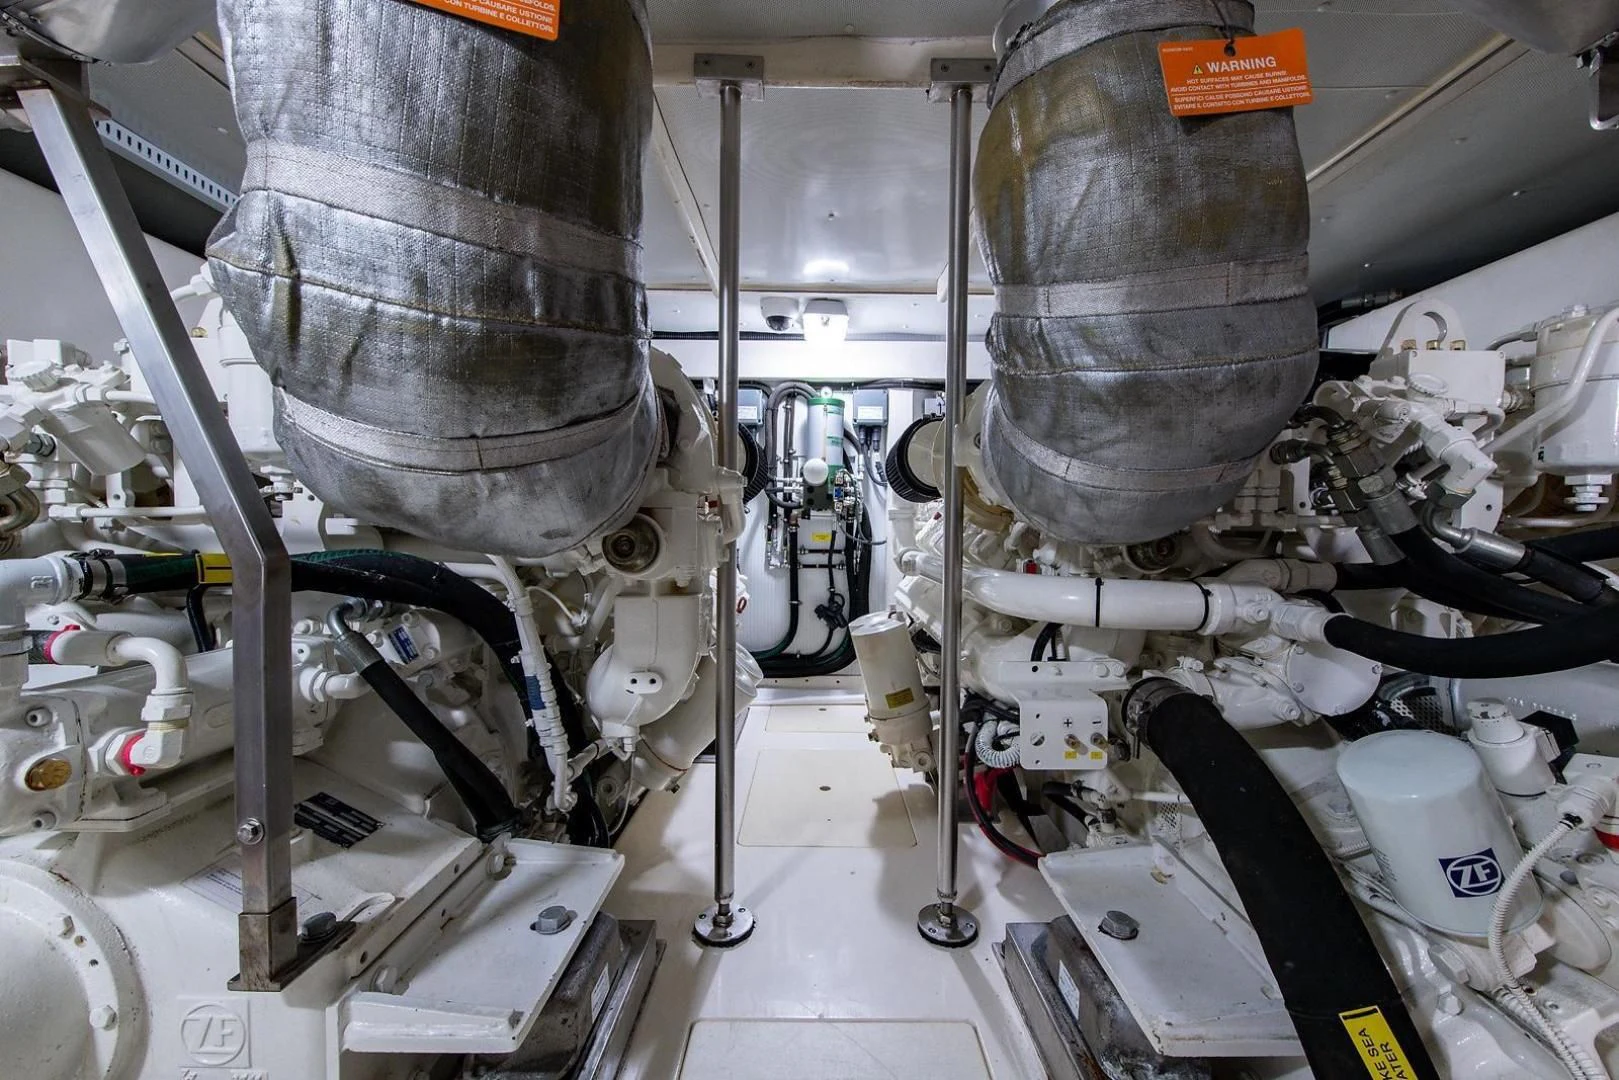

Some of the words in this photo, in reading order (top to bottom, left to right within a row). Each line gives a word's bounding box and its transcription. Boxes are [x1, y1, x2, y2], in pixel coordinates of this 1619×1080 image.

[464, 2, 497, 18] TURBINE
[499, 12, 505, 20] E
[1206, 56, 1277, 73] WARNING
[1174, 95, 1204, 103] SUPERFICI
[1450, 858, 1499, 889] ZF
[184, 1015, 238, 1055] ZF
[1358, 1028, 1380, 1057] SEA
[1380, 1042, 1408, 1080] ATER
